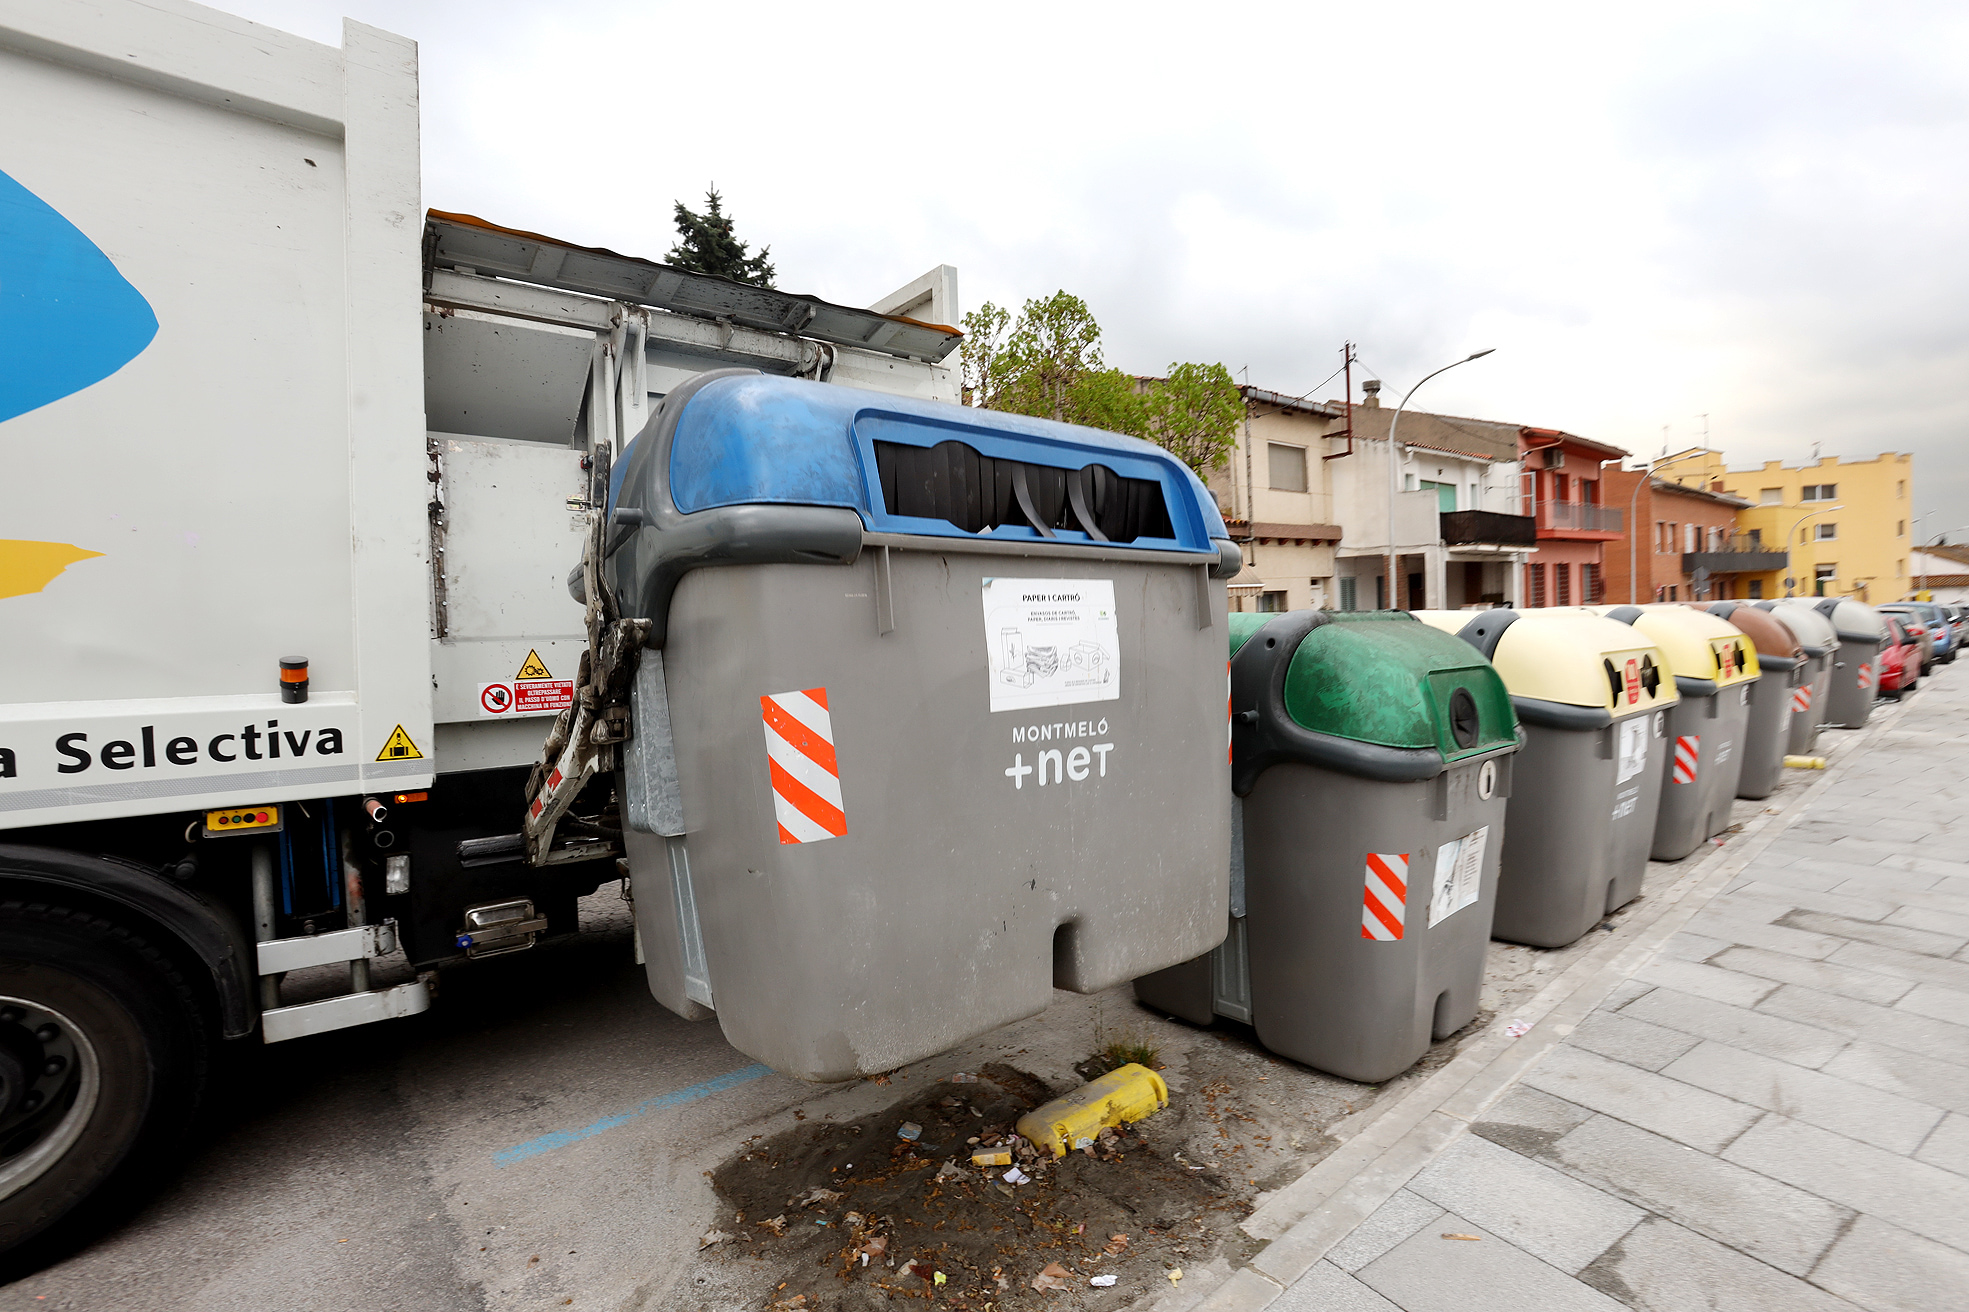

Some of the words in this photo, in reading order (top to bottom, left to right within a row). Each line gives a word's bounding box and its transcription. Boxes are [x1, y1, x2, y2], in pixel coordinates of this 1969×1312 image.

[1022, 594, 1046, 602] PAPER
[1052, 592, 1081, 602] CARTRÓ
[1012, 717, 1109, 744] MONTMELÓ
[55, 719, 344, 774] Selectiva
